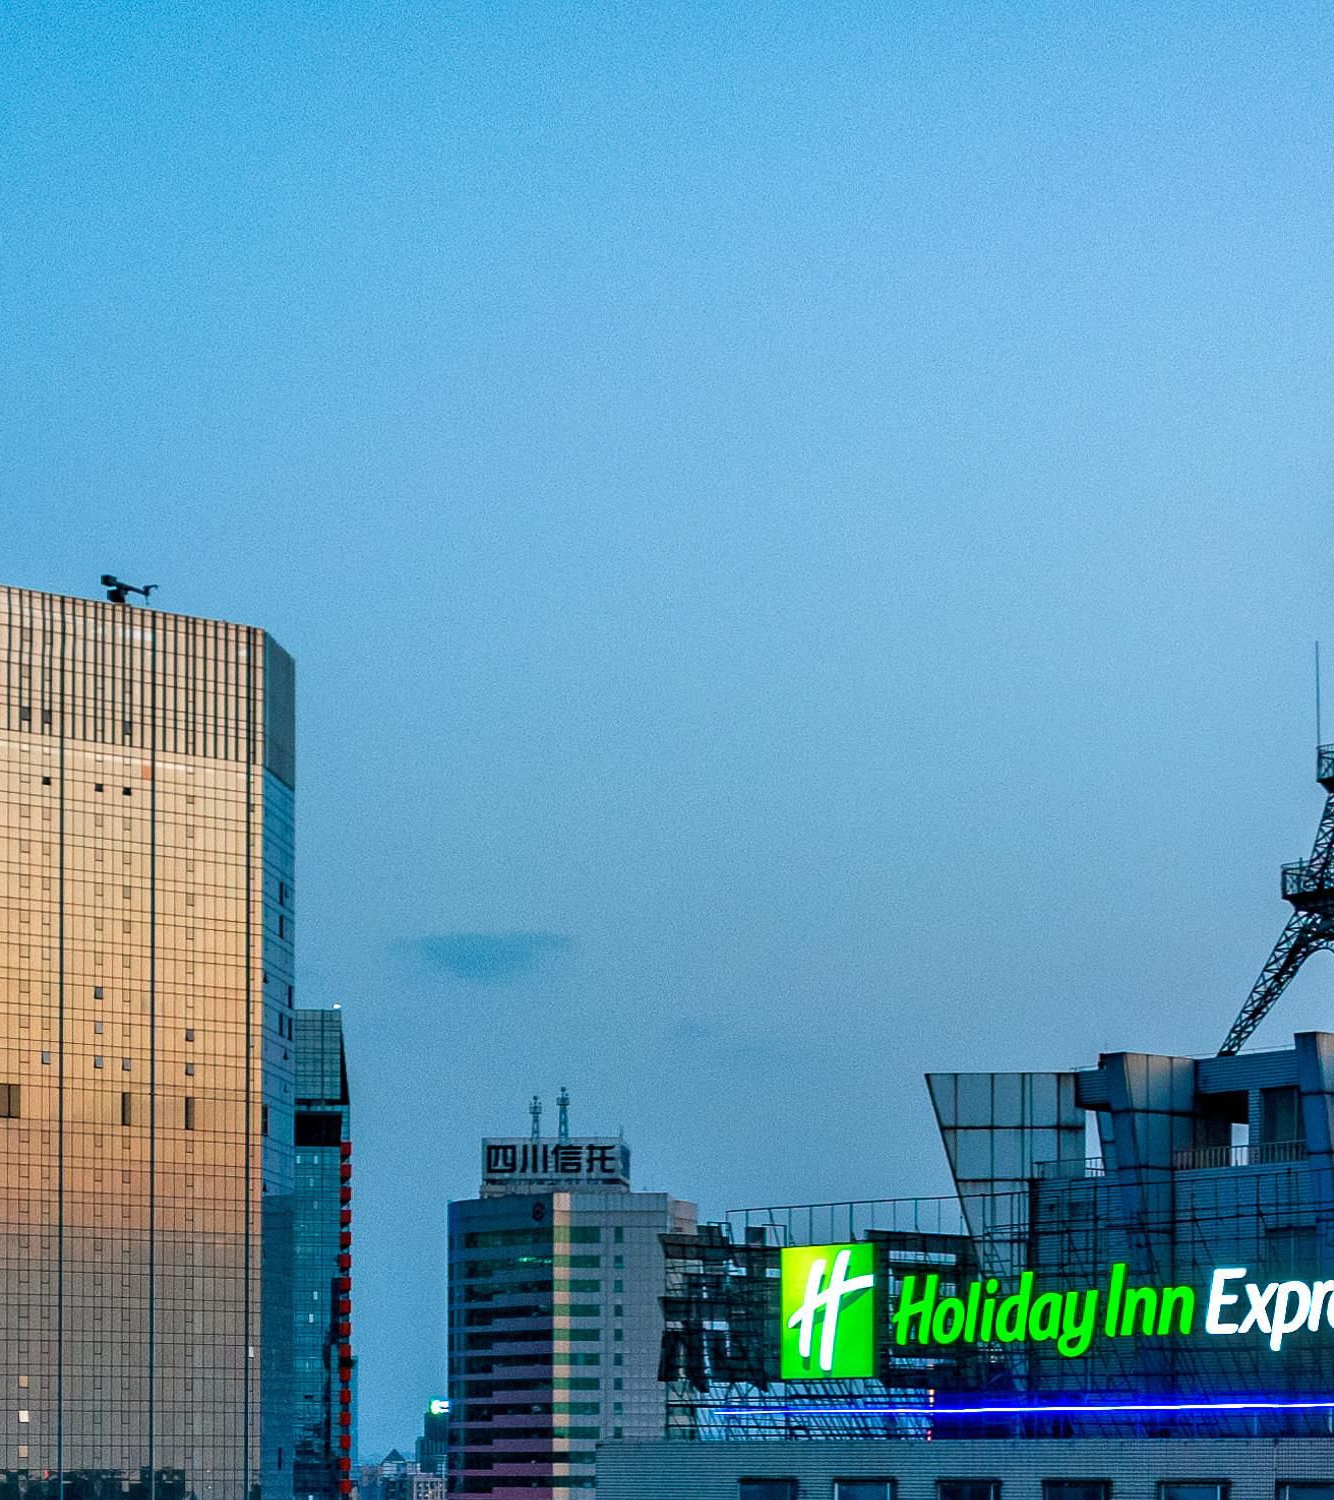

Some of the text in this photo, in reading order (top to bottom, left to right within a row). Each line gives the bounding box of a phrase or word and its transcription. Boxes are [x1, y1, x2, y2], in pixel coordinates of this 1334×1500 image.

[486, 1144, 617, 1174] 四川信托
[892, 1271, 1099, 1358] Holiday
[1104, 1262, 1195, 1338] Inn
